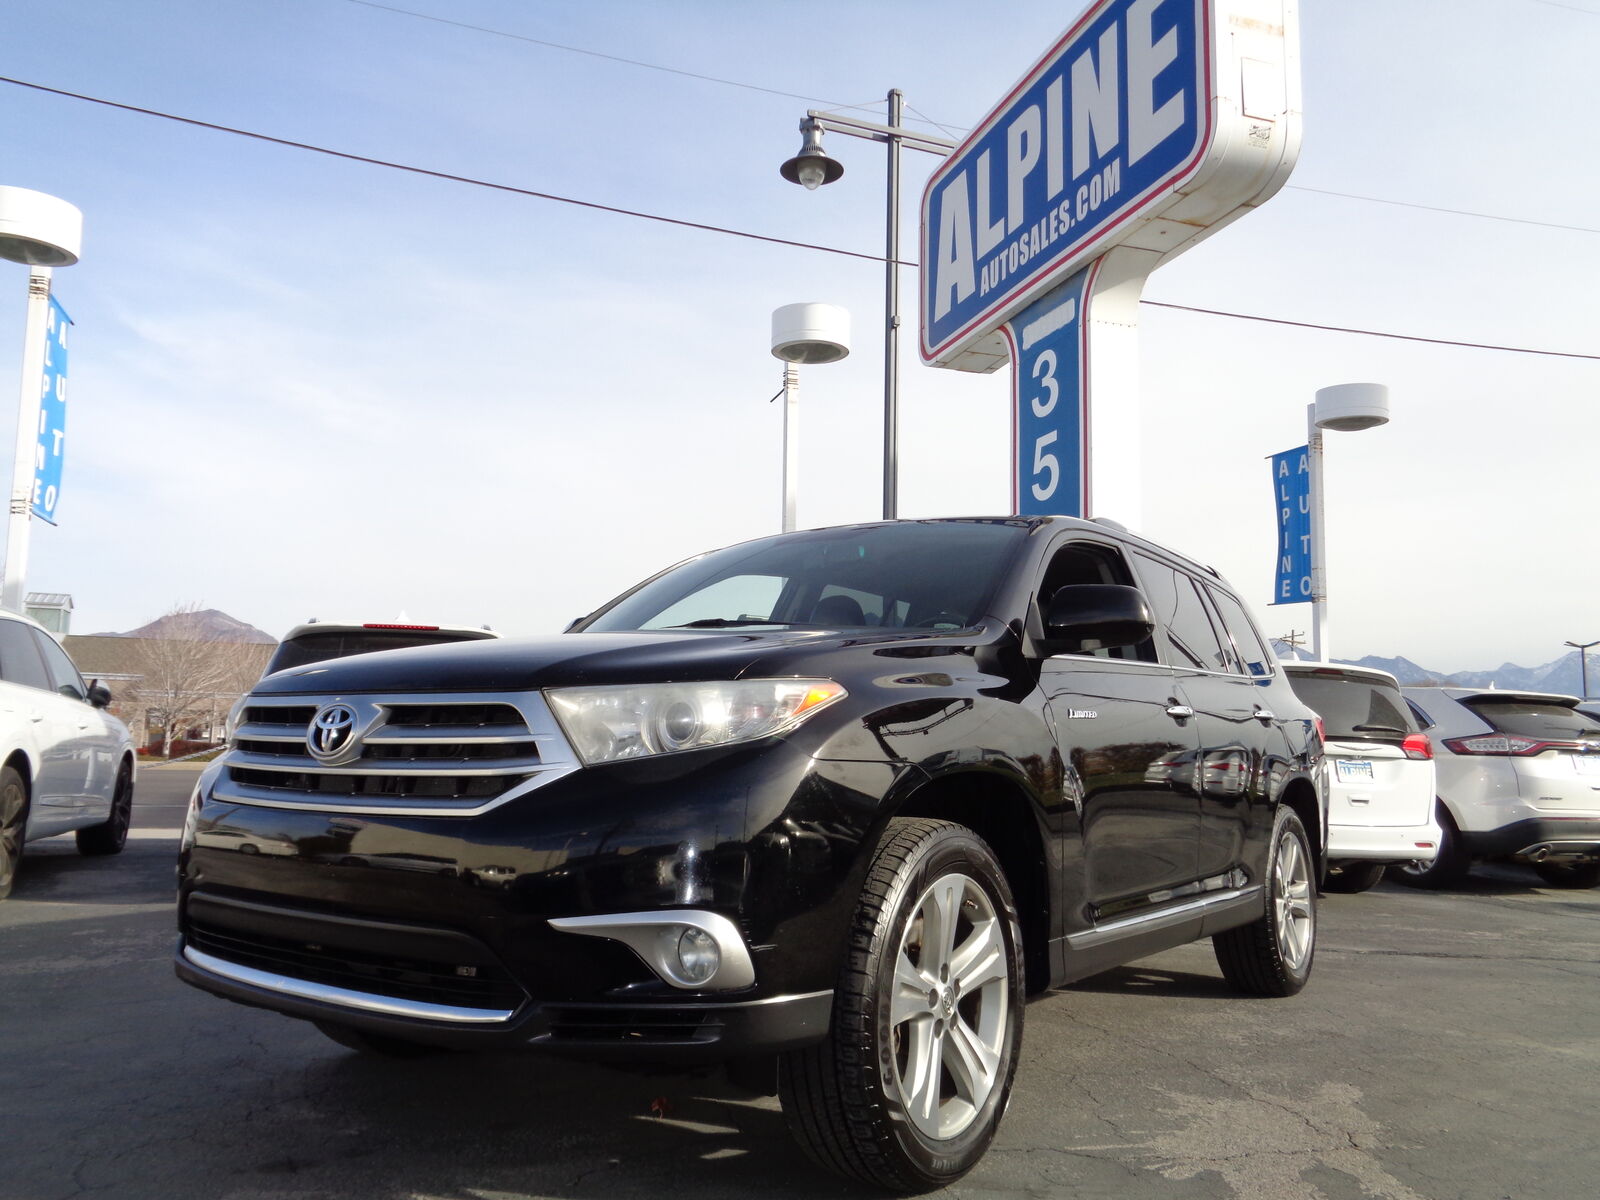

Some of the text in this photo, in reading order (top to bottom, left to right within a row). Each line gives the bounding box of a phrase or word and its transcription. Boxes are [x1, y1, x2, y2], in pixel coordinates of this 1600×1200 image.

[935, 0, 1185, 323] ALPINE
[980, 157, 1121, 298] AUTOSALES.COM
[34, 307, 55, 504] ALPINE
[44, 321, 67, 512] AUTO
[1279, 460, 1292, 598] ALPINE
[1298, 454, 1312, 596] AUTO
